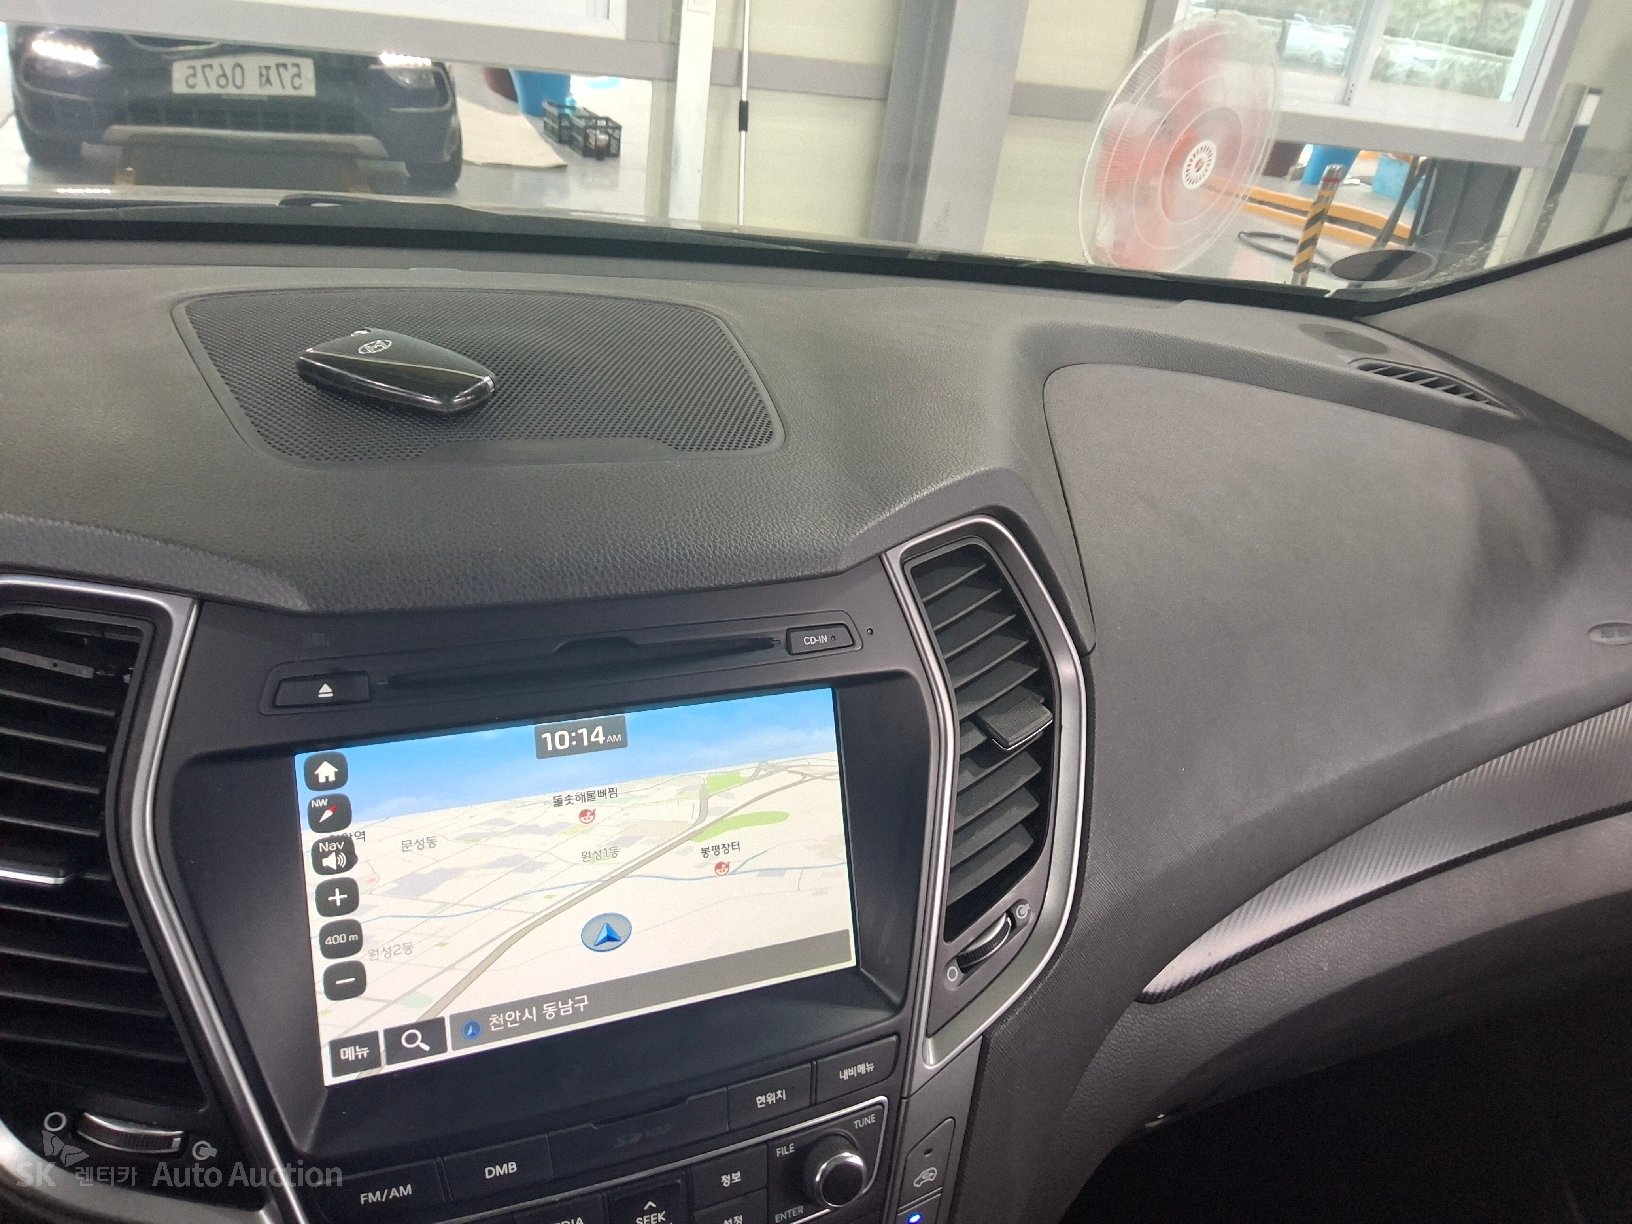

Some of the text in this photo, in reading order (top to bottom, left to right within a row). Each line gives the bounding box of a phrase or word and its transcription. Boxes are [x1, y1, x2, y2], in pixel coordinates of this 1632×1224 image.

[803, 634, 828, 646] CD-IN
[541, 725, 622, 751] 10:14 AM
[311, 798, 328, 808] NW
[319, 841, 345, 852] Nav
[701, 841, 741, 858] 봉평장터
[324, 933, 359, 945] 400 m
[488, 995, 590, 1031] 천안시 동남구
[340, 1045, 370, 1061] 메뉴
[839, 1062, 875, 1080] 내비메뉴
[755, 1089, 787, 1108] 현위치
[853, 1114, 876, 1129] TUNE
[775, 1143, 795, 1157] FILE
[484, 1161, 518, 1179] DMB
[721, 1171, 742, 1187] 정보
[360, 1184, 413, 1205] FM/AM
[635, 1210, 666, 1224] SEEK
[775, 1206, 804, 1223] ENTER
